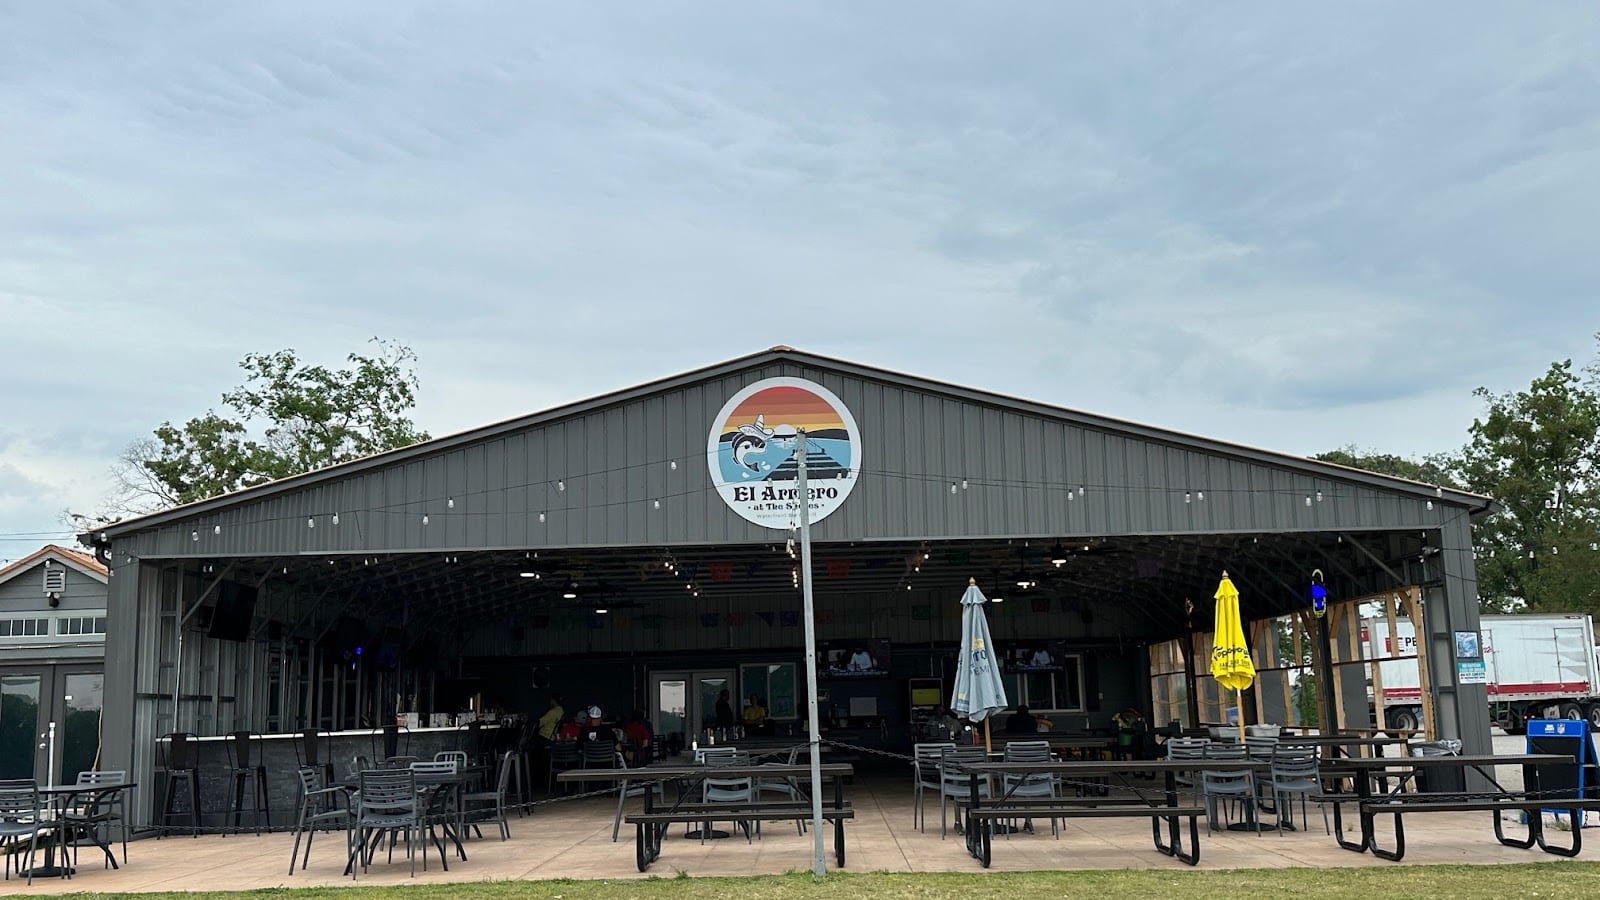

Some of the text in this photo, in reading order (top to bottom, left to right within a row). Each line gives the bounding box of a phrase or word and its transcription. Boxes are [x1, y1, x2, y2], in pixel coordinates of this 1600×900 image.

[733, 486, 838, 501] El Arrero
[753, 503, 763, 511] at
